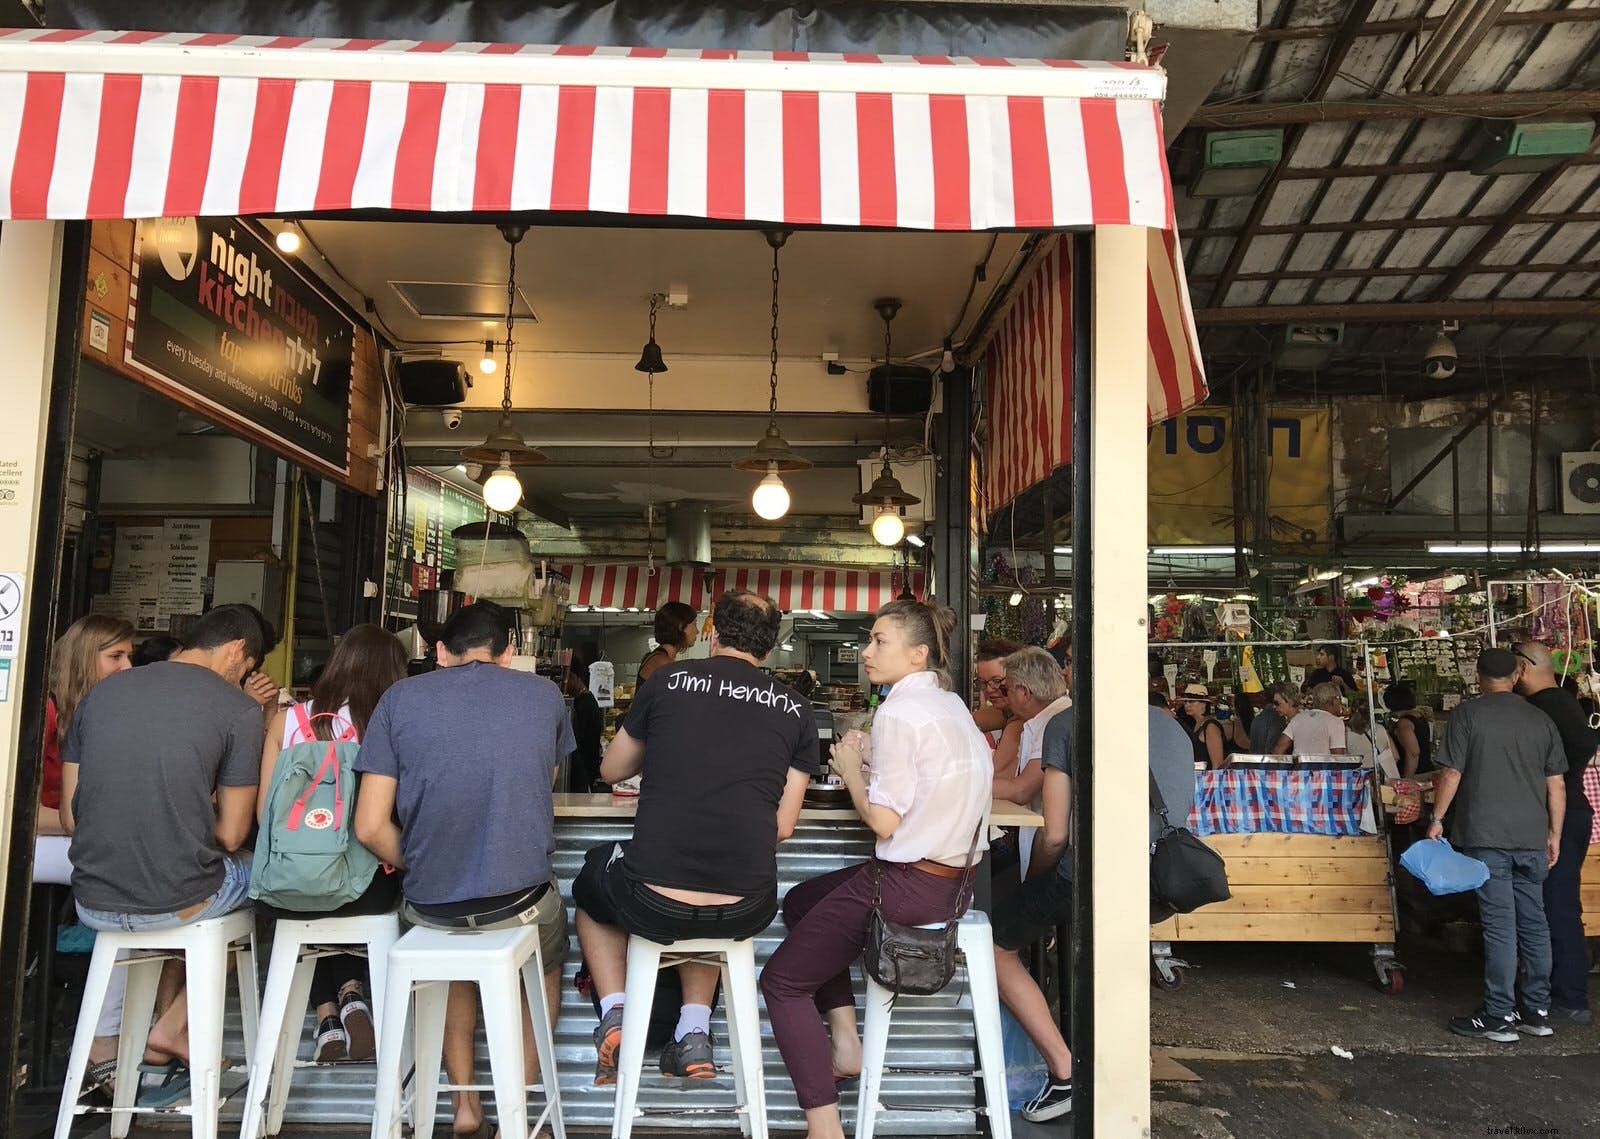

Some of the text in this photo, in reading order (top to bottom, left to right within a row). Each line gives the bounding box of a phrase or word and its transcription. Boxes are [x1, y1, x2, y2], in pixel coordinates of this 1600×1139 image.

[211, 228, 273, 308] night
[198, 259, 287, 353] kitchen
[274, 284, 318, 348] מטבח
[166, 340, 187, 363] every
[188, 350, 214, 378] tuesday
[214, 368, 227, 383] and
[227, 376, 258, 403] wednesday
[270, 366, 303, 405] drinks
[285, 336, 322, 387] לילה
[667, 670, 802, 718] Jimi Hendrix
[1471, 1018, 1485, 1029] N
